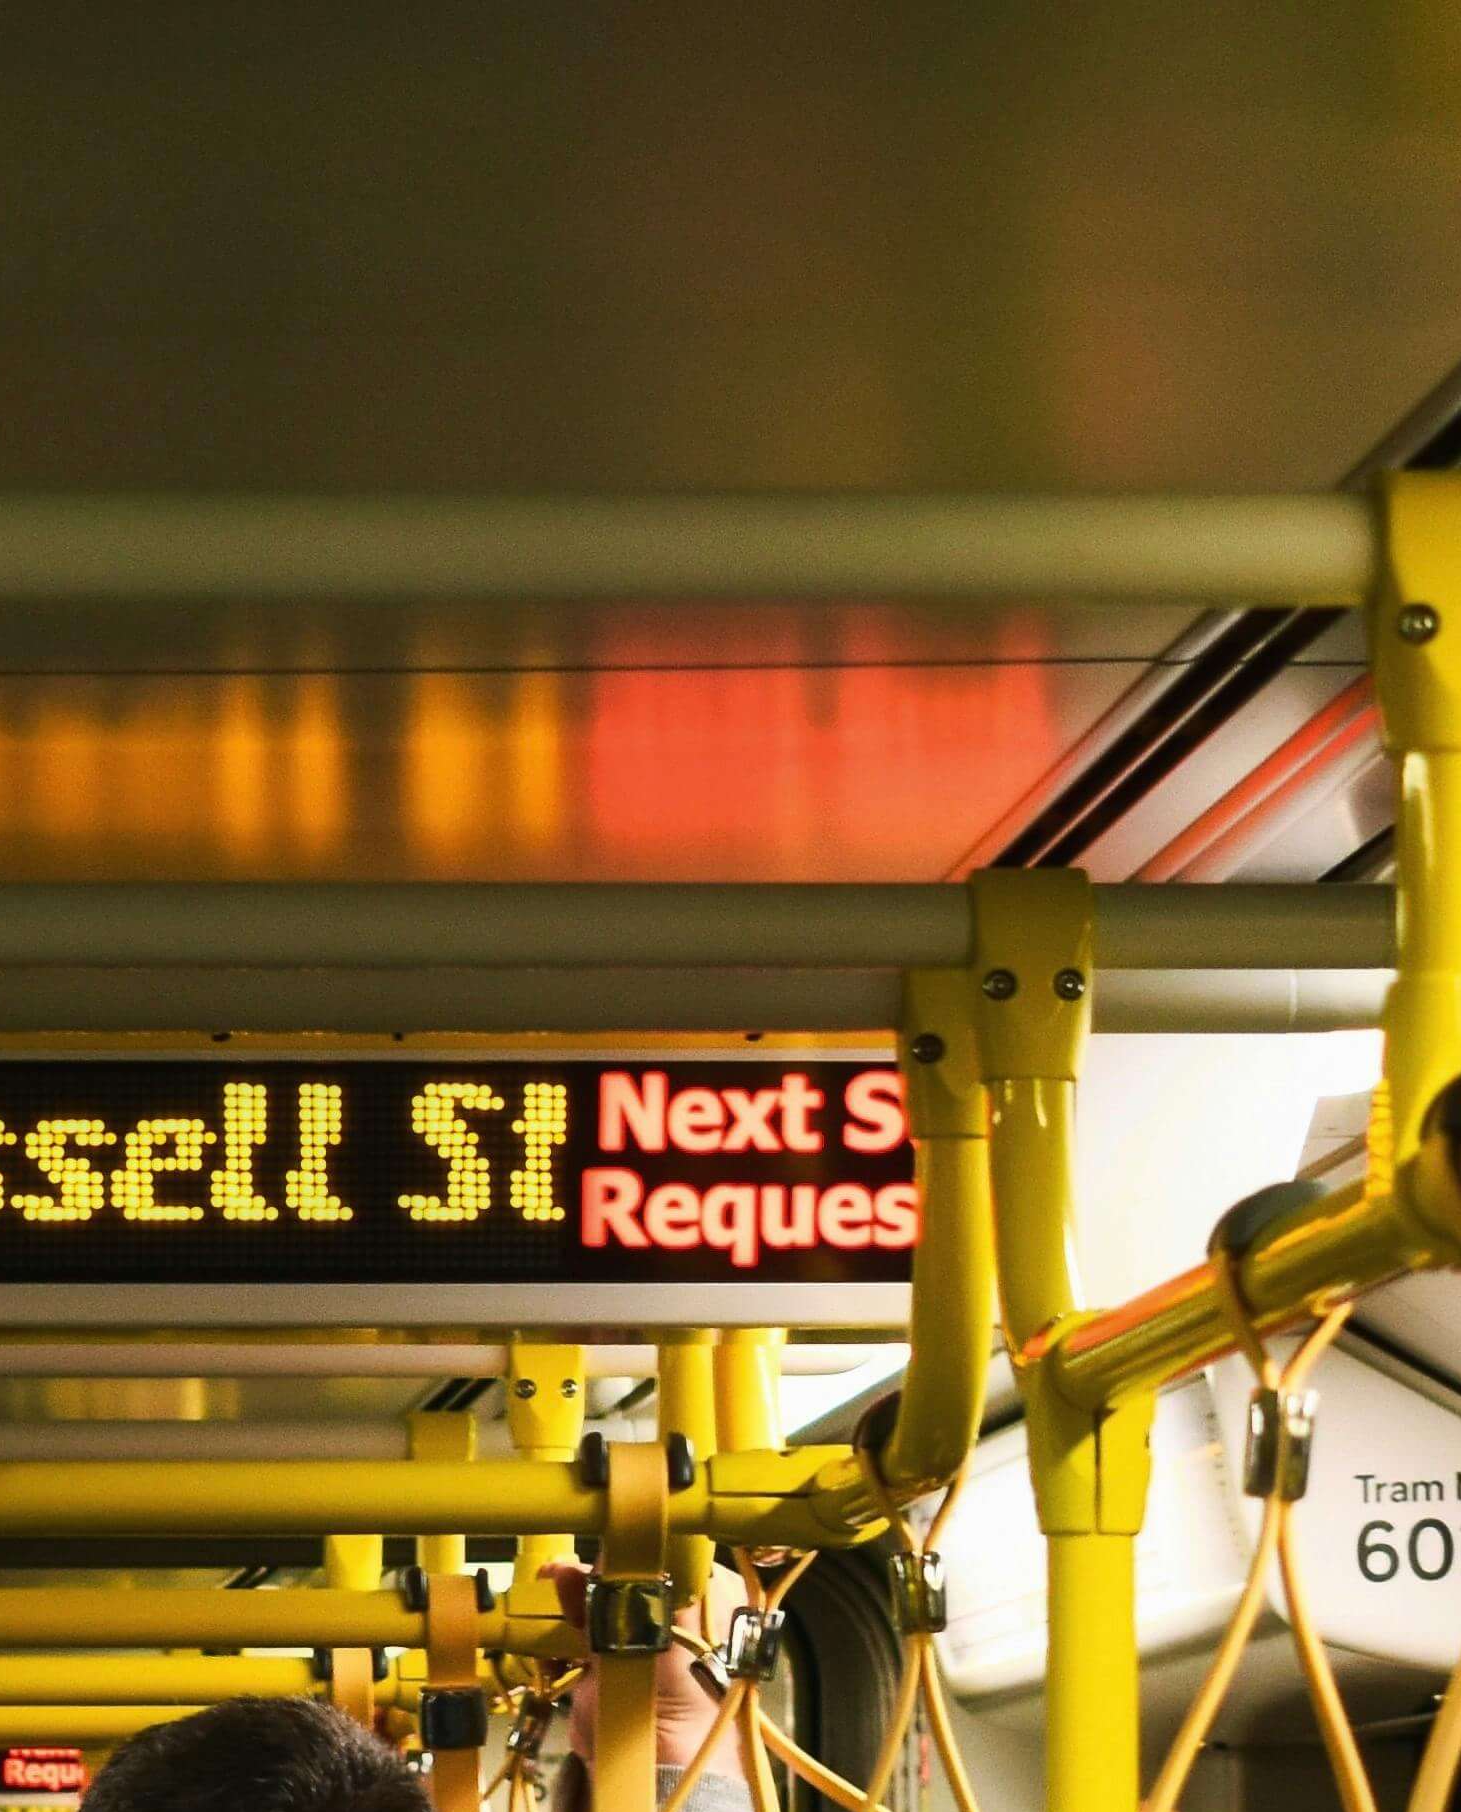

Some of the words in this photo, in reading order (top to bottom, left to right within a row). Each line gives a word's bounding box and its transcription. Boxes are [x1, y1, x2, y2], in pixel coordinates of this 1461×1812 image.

[397, 1081, 568, 1222] St
[597, 1069, 825, 1153] Next
[1353, 1474, 1445, 1503] Tram
